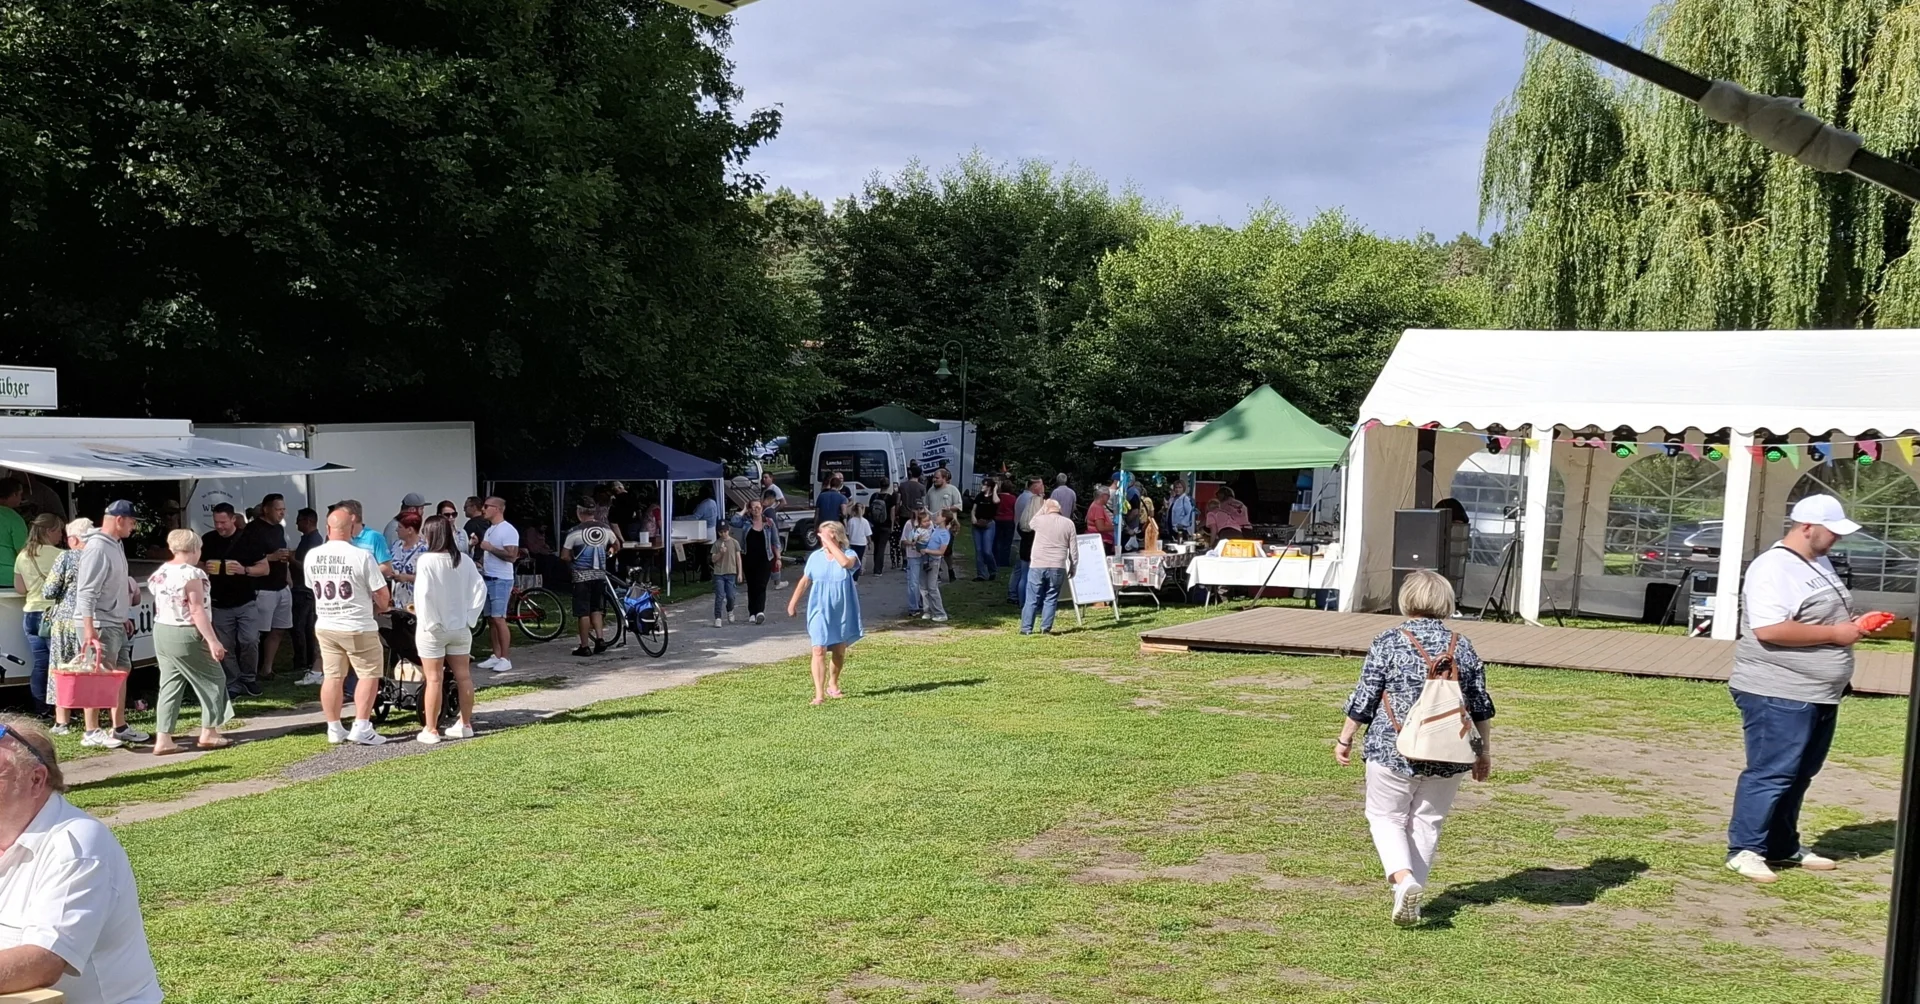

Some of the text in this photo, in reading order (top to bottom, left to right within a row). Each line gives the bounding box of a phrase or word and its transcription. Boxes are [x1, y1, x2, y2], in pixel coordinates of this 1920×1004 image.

[316, 555, 346, 564] APE SHALL
[329, 566, 340, 575] KILL
[341, 566, 353, 575] APE
